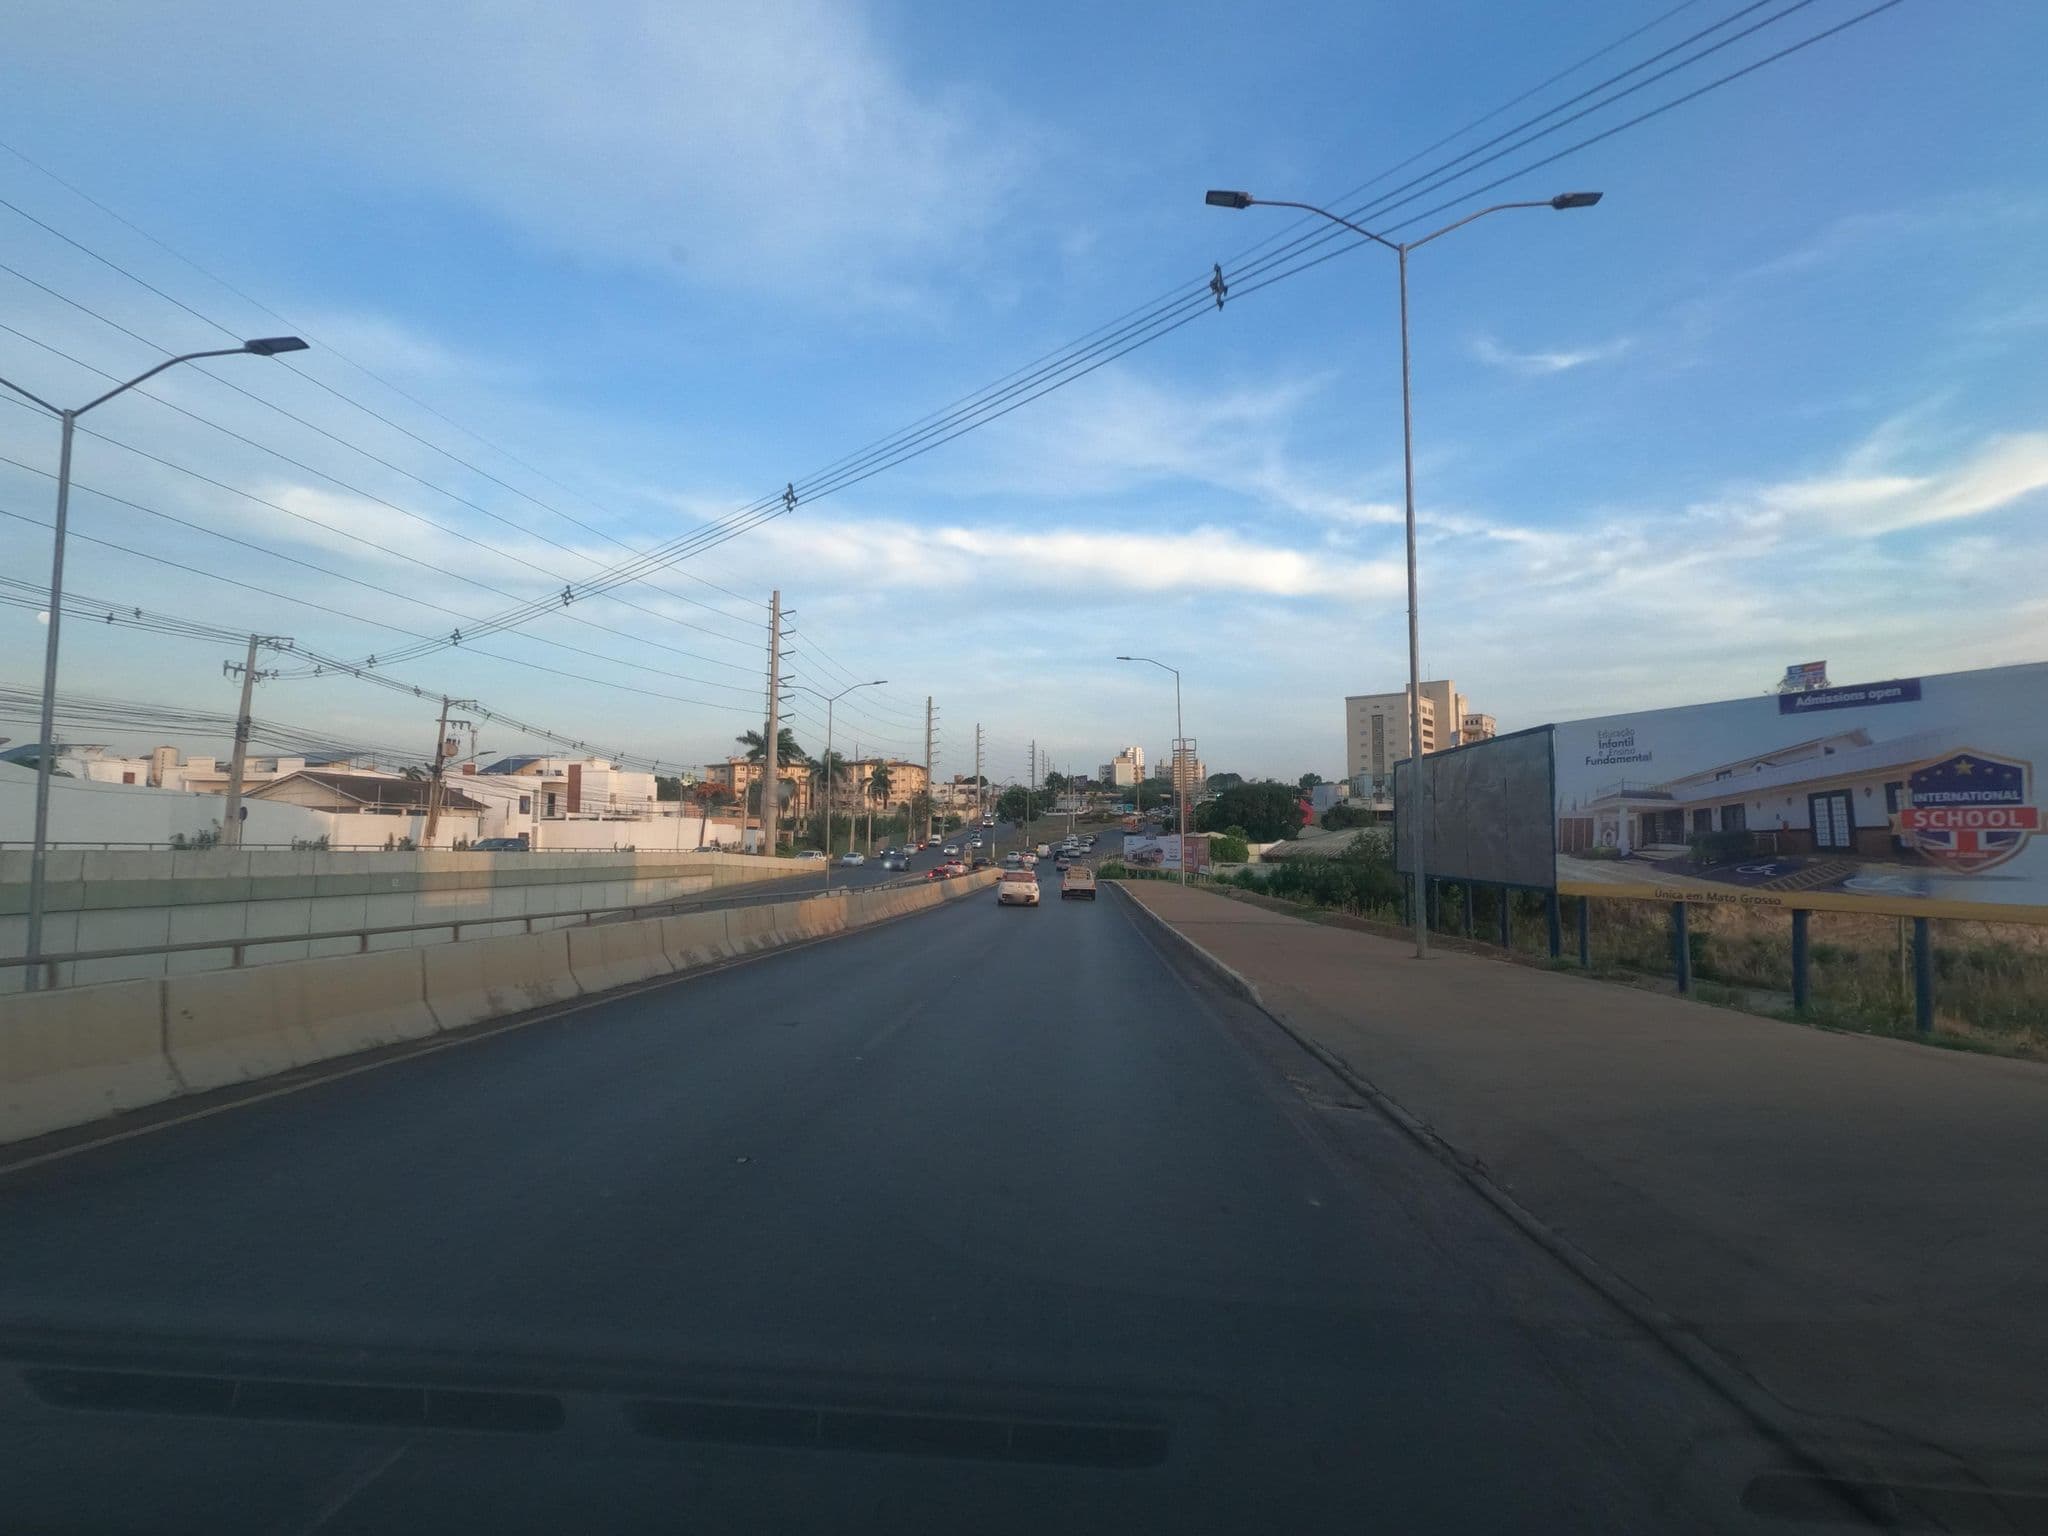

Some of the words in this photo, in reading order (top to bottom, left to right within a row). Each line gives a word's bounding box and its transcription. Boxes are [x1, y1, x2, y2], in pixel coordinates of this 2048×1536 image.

[1796, 689, 1865, 706] Admissions
[1868, 687, 1902, 702] open
[1599, 736, 1634, 749] Infantil
[1585, 752, 1653, 766] Fundamental
[1914, 790, 2021, 802] INTERNATIONAL
[1914, 810, 2024, 827] SCHOOL
[1686, 893, 1703, 901] em
[1707, 892, 1737, 903] Mato
[1740, 893, 1782, 905] Grosso
